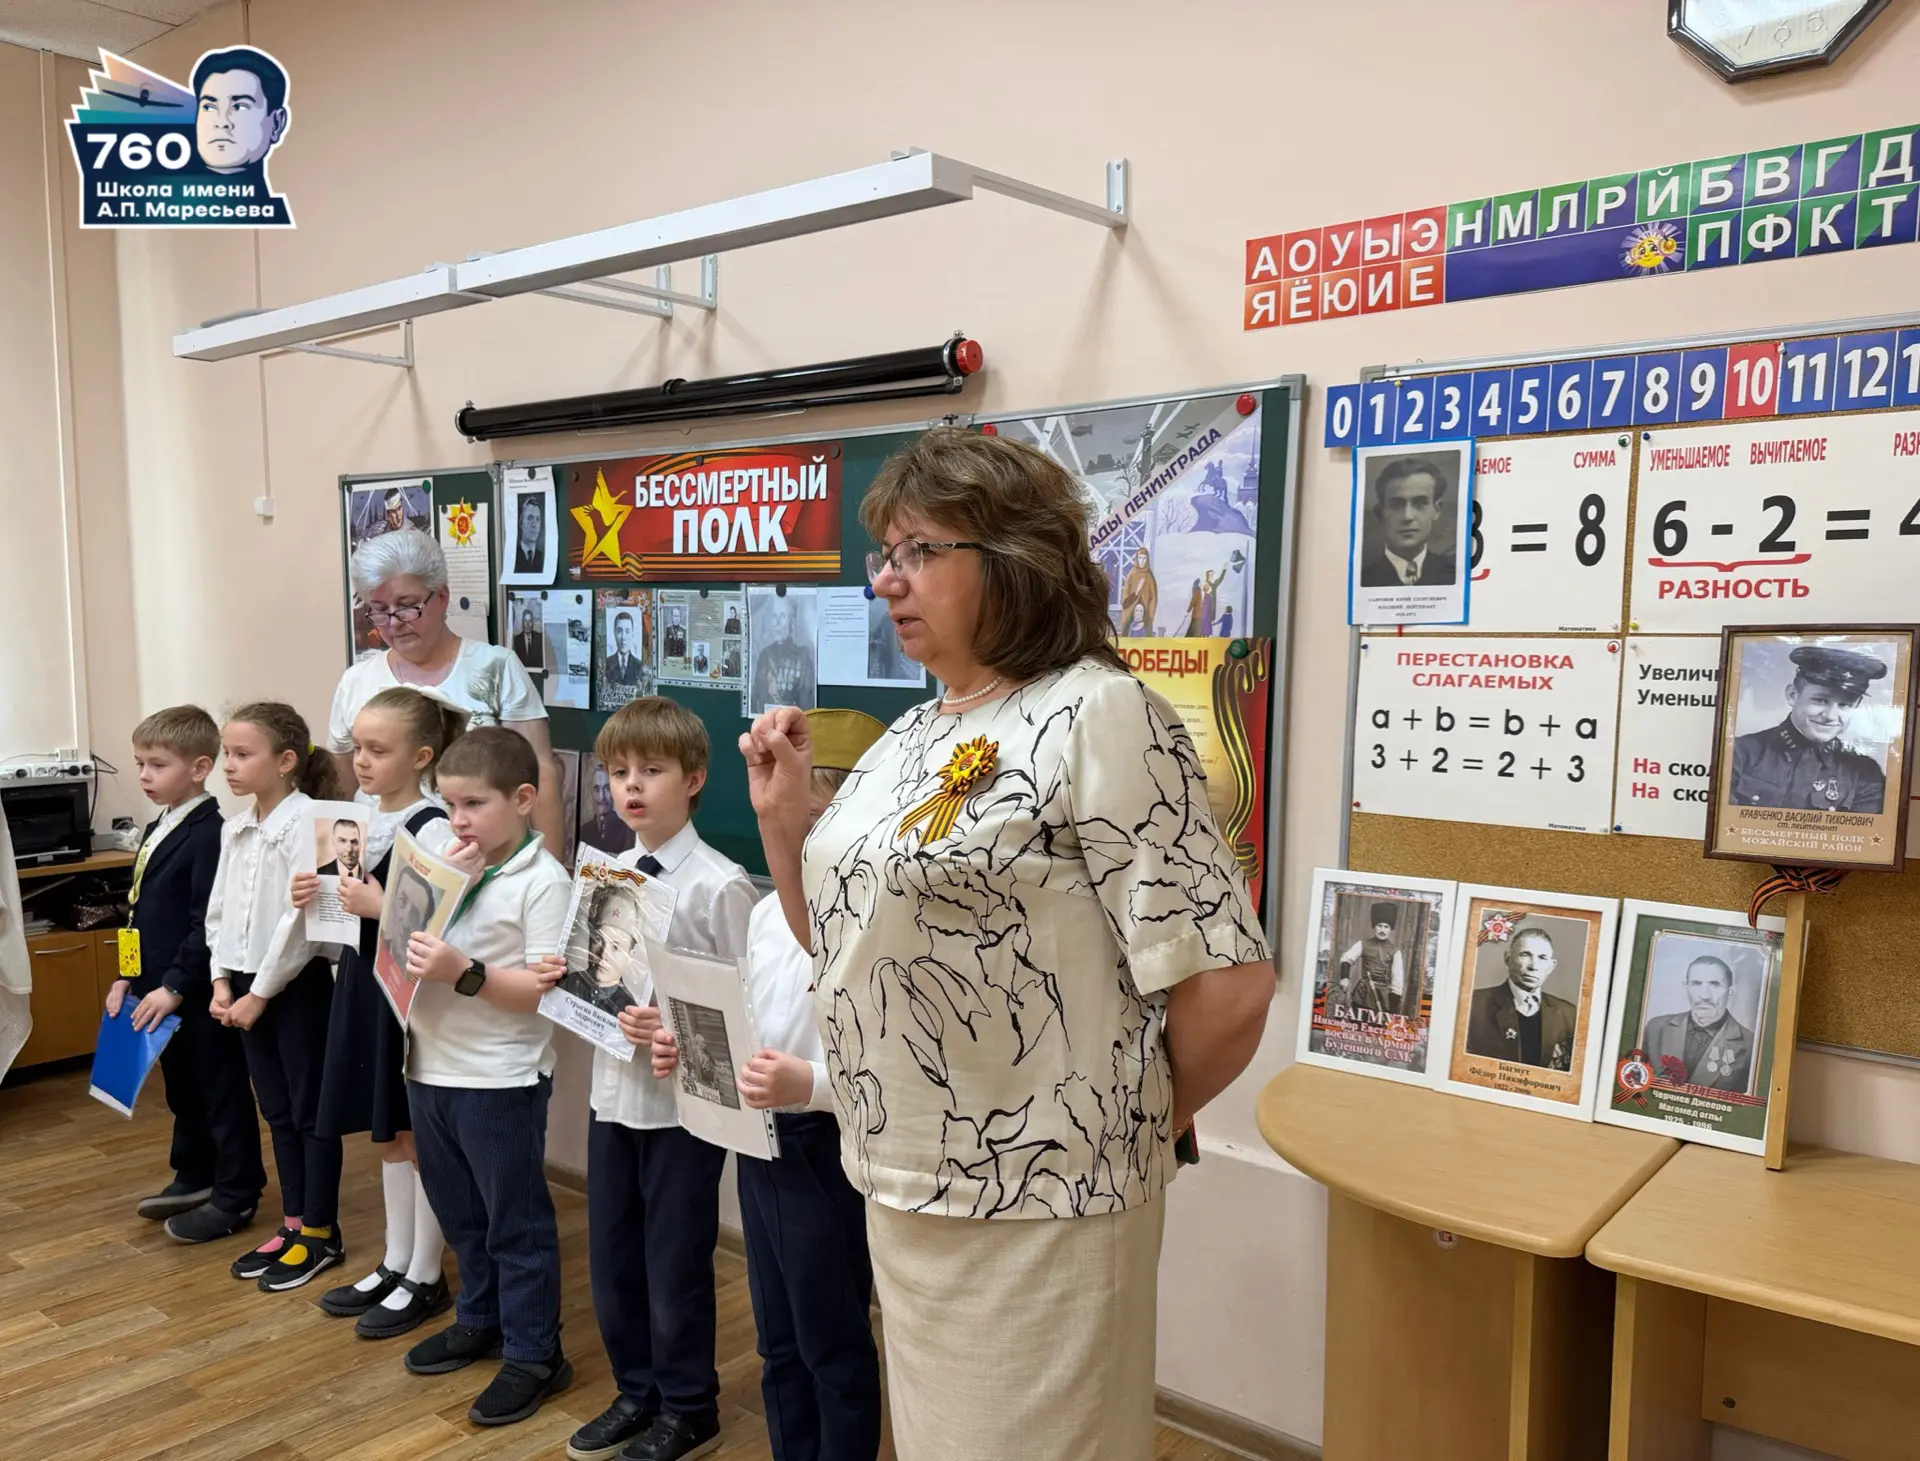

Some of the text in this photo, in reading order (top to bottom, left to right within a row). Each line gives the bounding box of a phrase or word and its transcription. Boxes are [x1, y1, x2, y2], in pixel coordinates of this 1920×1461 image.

[1573, 450, 1616, 469] СУММА
[1650, 444, 1731, 472] УМЕНЬШАЕМОЕ
[1750, 437, 1828, 466] ВЫЧИТАЕМОЕ
[635, 455, 828, 508] БЕССМЕРТНЫЙ
[1124, 427, 1222, 517] ЛЕНИНГРАДА
[672, 505, 789, 555] ПОЛК
[1575, 493, 1606, 567] 8
[1652, 500, 1688, 557] 6
[1758, 495, 1796, 553] 2
[1658, 579, 1810, 600] РАЗНОСТЬ
[1397, 653, 1575, 670] ПЕРЕСТАНОВКА
[1412, 673, 1554, 690] СЛАГАЕМЫХ
[1371, 709, 1390, 729] a
[1435, 706, 1455, 732] b
[1504, 709, 1525, 736] b
[1575, 717, 1597, 740] a
[1371, 743, 1386, 769] 3
[1432, 747, 1449, 774] 2
[1498, 751, 1516, 778] 2
[1567, 755, 1585, 783] 3
[1633, 758, 1711, 777] На ско
[1632, 783, 1660, 799] На
[1740, 809, 1874, 827] КРАВЧЕНКО ВАСИЛИЙ ТИХОНОВИЧ
[1741, 828, 1865, 843] БЕССМЕРТНЫЙ ПОЛК
[1742, 837, 1862, 852] МОЖАЙСКИЙ РАЙОН
[1313, 1014, 1358, 1031] Никифор
[1334, 1004, 1409, 1027] БАГМУТ
[1498, 1062, 1530, 1076] Багмут
[1498, 1072, 1561, 1092] Никифорович
[1658, 1102, 1723, 1122] Магомед оглы
